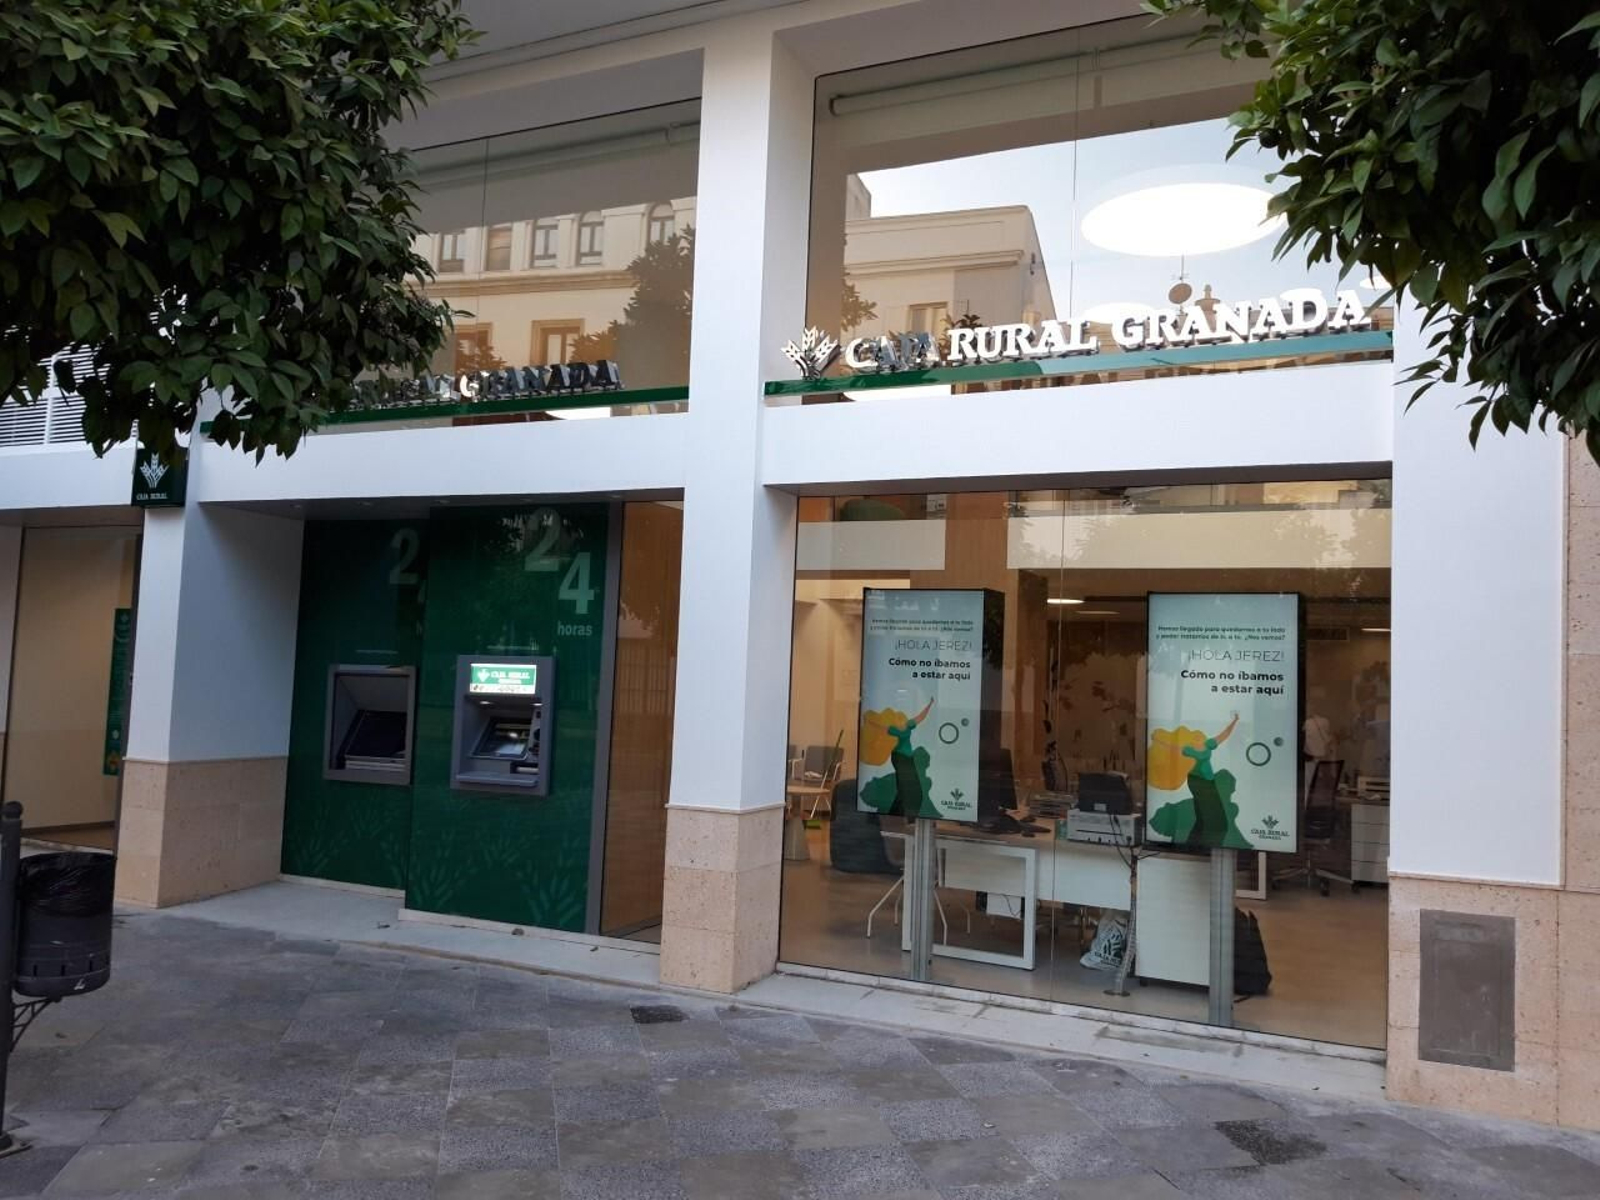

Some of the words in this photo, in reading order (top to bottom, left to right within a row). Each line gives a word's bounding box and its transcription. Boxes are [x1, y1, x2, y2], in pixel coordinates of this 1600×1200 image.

[947, 319, 1099, 361] RURAL
[1111, 288, 1372, 346] GRANADA
[557, 620, 593, 637] horas
[932, 640, 972, 651] JEREZ!
[888, 657, 917, 667] Cómo
[919, 659, 932, 667] no
[1235, 650, 1285, 662] JEREZ!
[912, 671, 918, 679] a
[920, 670, 945, 679] estar
[1180, 669, 1216, 680] Cómo
[1219, 671, 1235, 681] no
[1238, 670, 1285, 682] íbamos
[1211, 685, 1218, 693] a
[1221, 684, 1253, 694] estar
[1256, 684, 1285, 697] aquí
